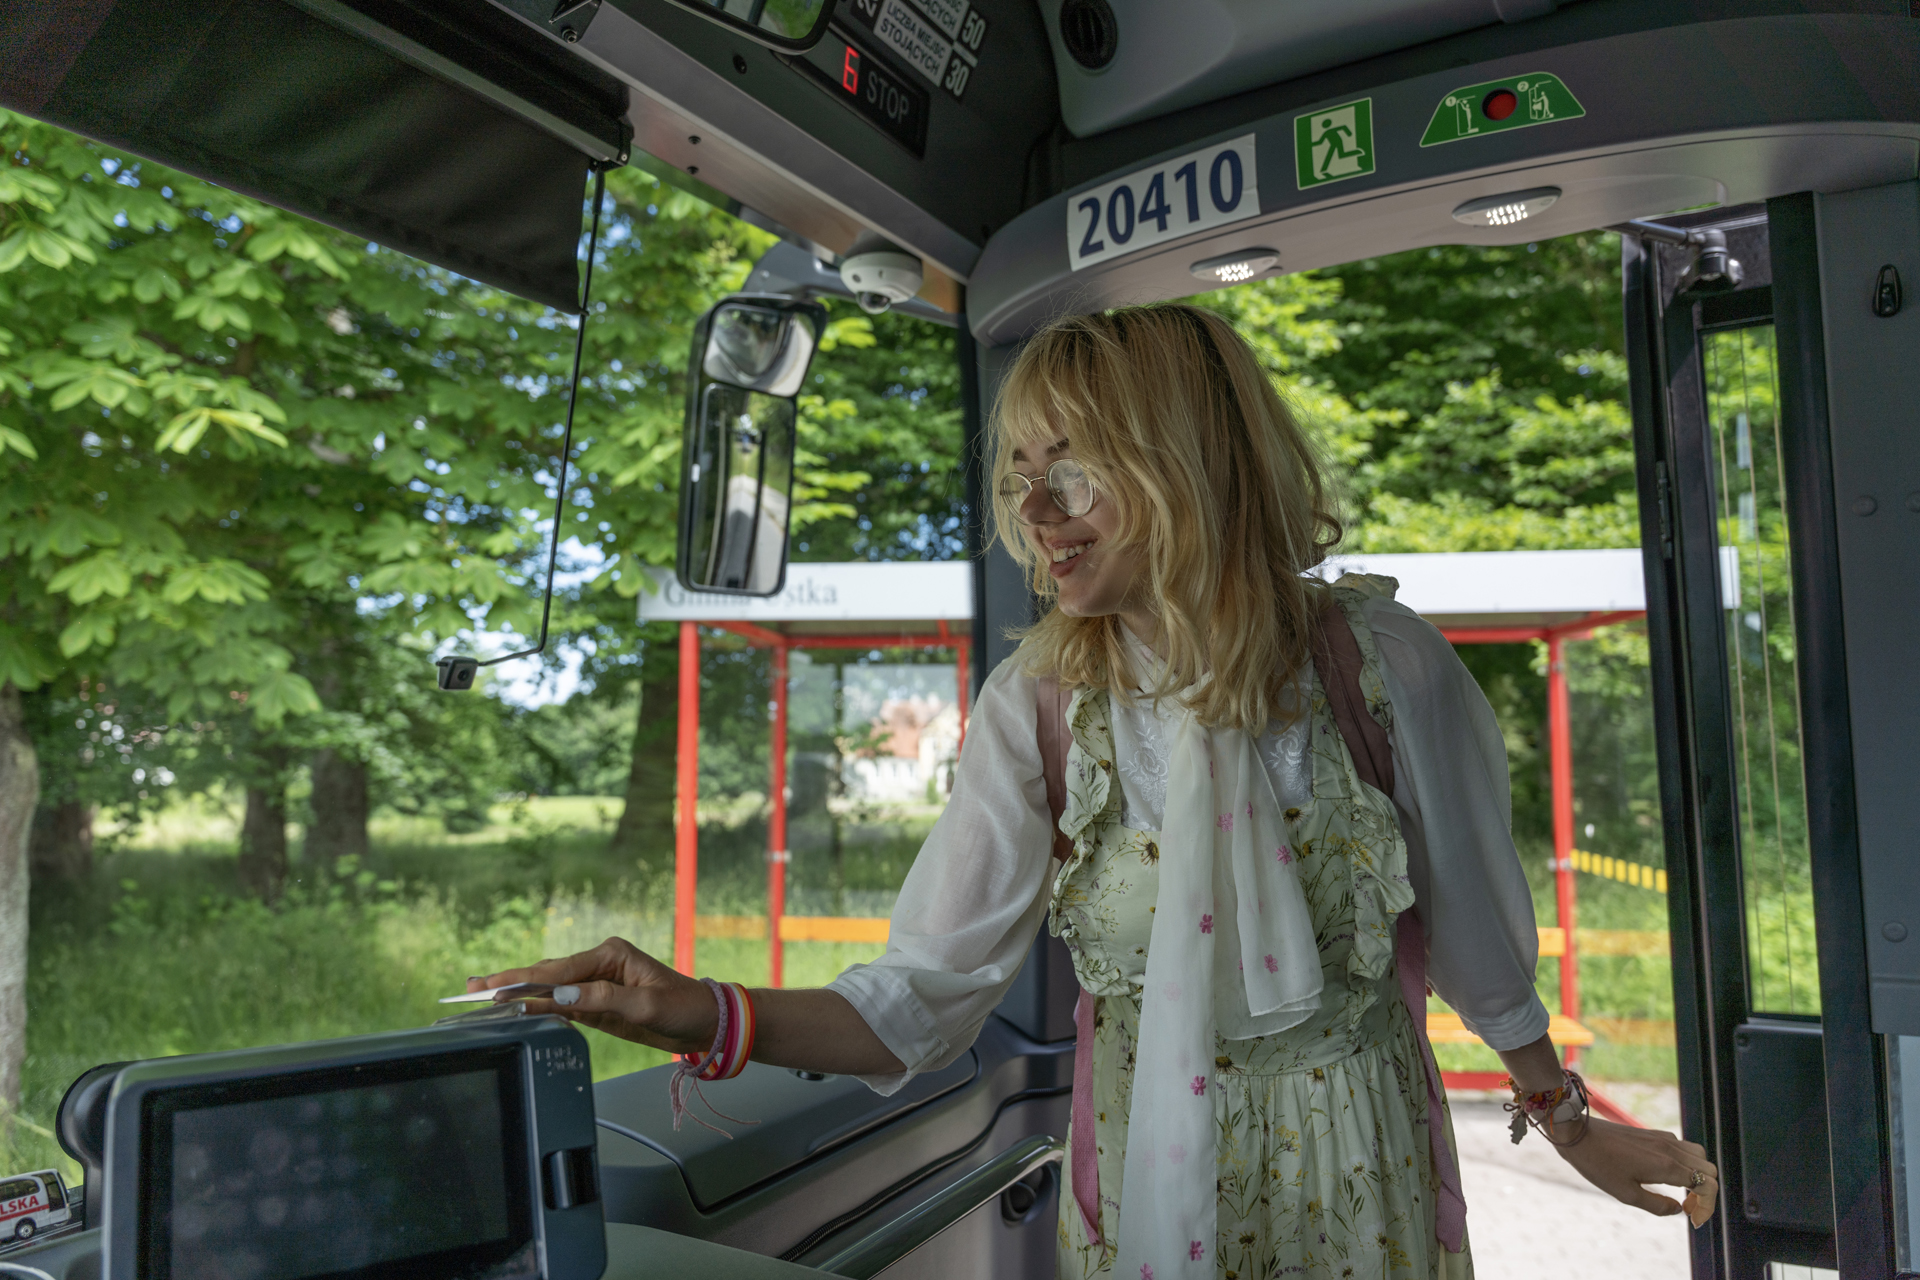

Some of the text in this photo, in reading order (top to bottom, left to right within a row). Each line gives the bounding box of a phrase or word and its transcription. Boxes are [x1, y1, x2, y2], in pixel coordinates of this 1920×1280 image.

[880, 18, 940, 76] STOJĄCYCH
[886, 1, 916, 36] LICZBA
[917, 26, 946, 59] MIEJSC
[961, 10, 986, 50] 50
[842, 45, 859, 95] 6
[945, 58, 969, 96] 30
[867, 71, 909, 124] STOP
[1079, 150, 1243, 258] 20410
